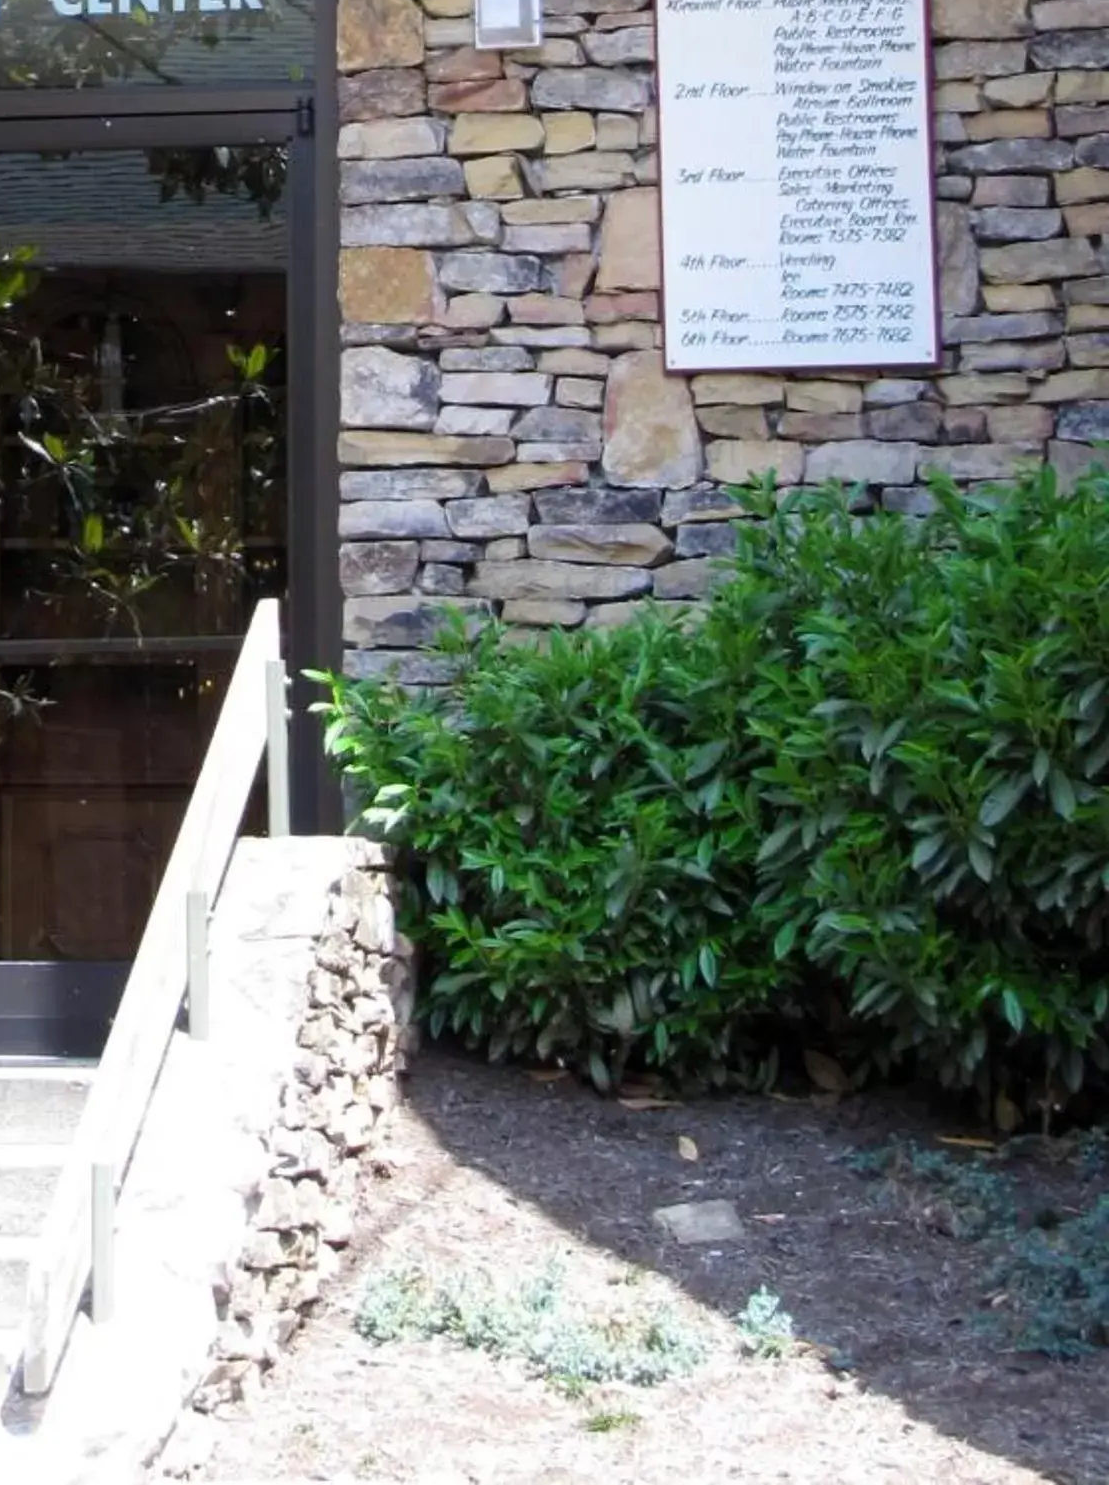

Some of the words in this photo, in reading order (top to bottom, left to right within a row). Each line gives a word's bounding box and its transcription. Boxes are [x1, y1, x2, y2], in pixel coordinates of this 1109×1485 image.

[773, 26, 816, 41] Public
[825, 24, 906, 39] Restrooms
[879, 39, 917, 52] Phone
[774, 59, 815, 74] Water
[819, 56, 883, 71] Fountain
[674, 82, 707, 100] 2nd
[709, 81, 750, 99] Floor
[774, 81, 830, 95] Window
[858, 77, 917, 94] Smokies
[793, 96, 841, 110] Atrium
[845, 95, 913, 109] Ballroom
[776, 112, 818, 127] Public
[823, 111, 900, 126] Restrooms
[776, 145, 815, 159] Water
[820, 143, 877, 157] Fountain
[678, 167, 704, 184] 3rd
[778, 166, 842, 181] Executive
[847, 164, 898, 179] Offices
[824, 181, 894, 199] Marketing
[795, 197, 854, 215] Catering
[859, 196, 910, 211] Offices
[780, 214, 843, 229] Executive
[849, 213, 889, 227] Board
[779, 251, 837, 271] Vending
[780, 283, 829, 299] Rooms
[781, 307, 829, 323] Rooms
[781, 328, 829, 344] Rooms
